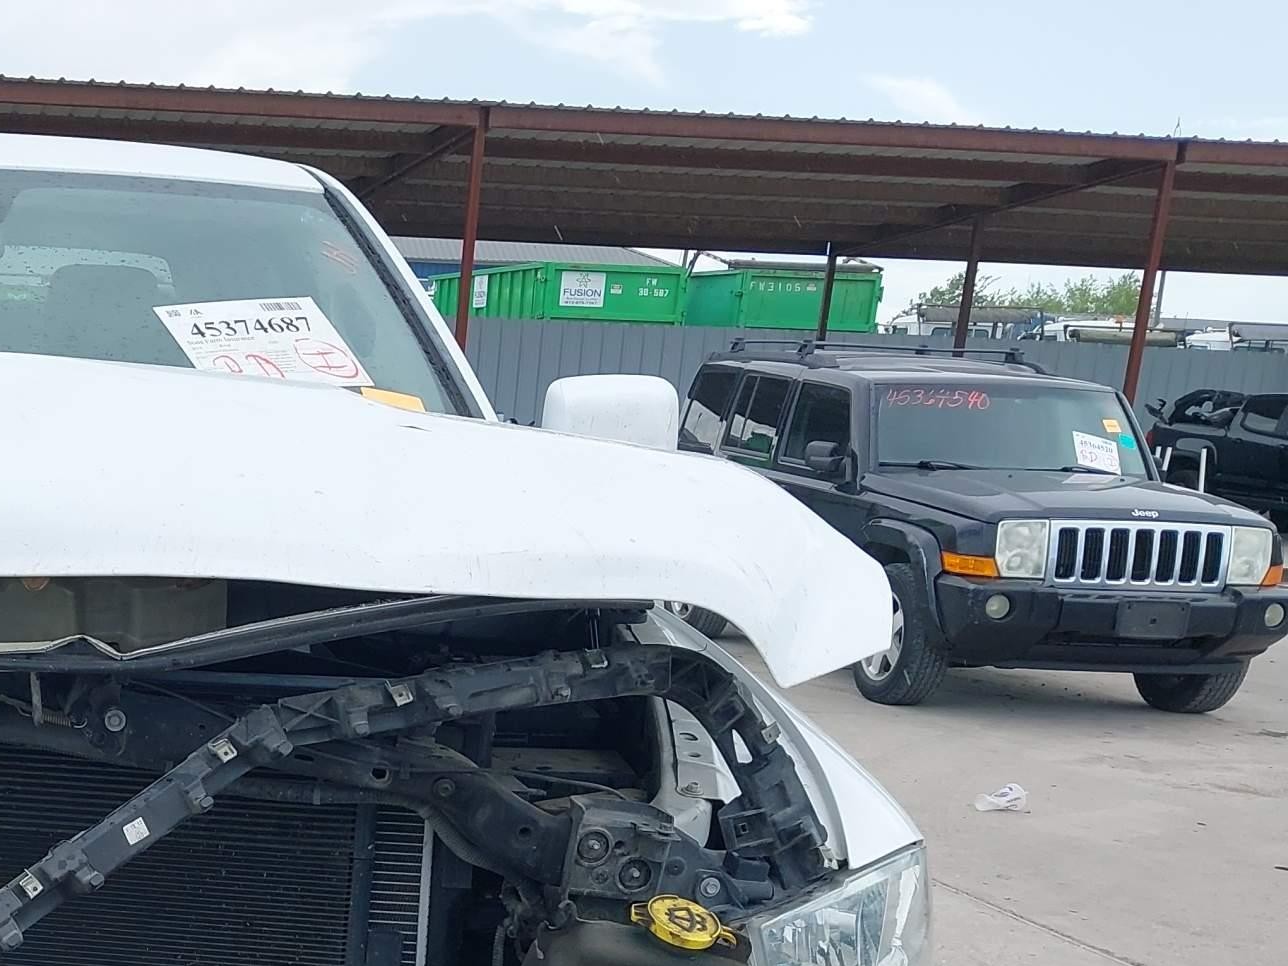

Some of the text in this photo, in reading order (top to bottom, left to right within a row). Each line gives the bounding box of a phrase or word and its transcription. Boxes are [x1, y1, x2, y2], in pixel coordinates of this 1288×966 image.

[563, 288, 602, 298] FUSION
[190, 315, 311, 338] 45374687
[1131, 508, 1159, 519] Jeep
